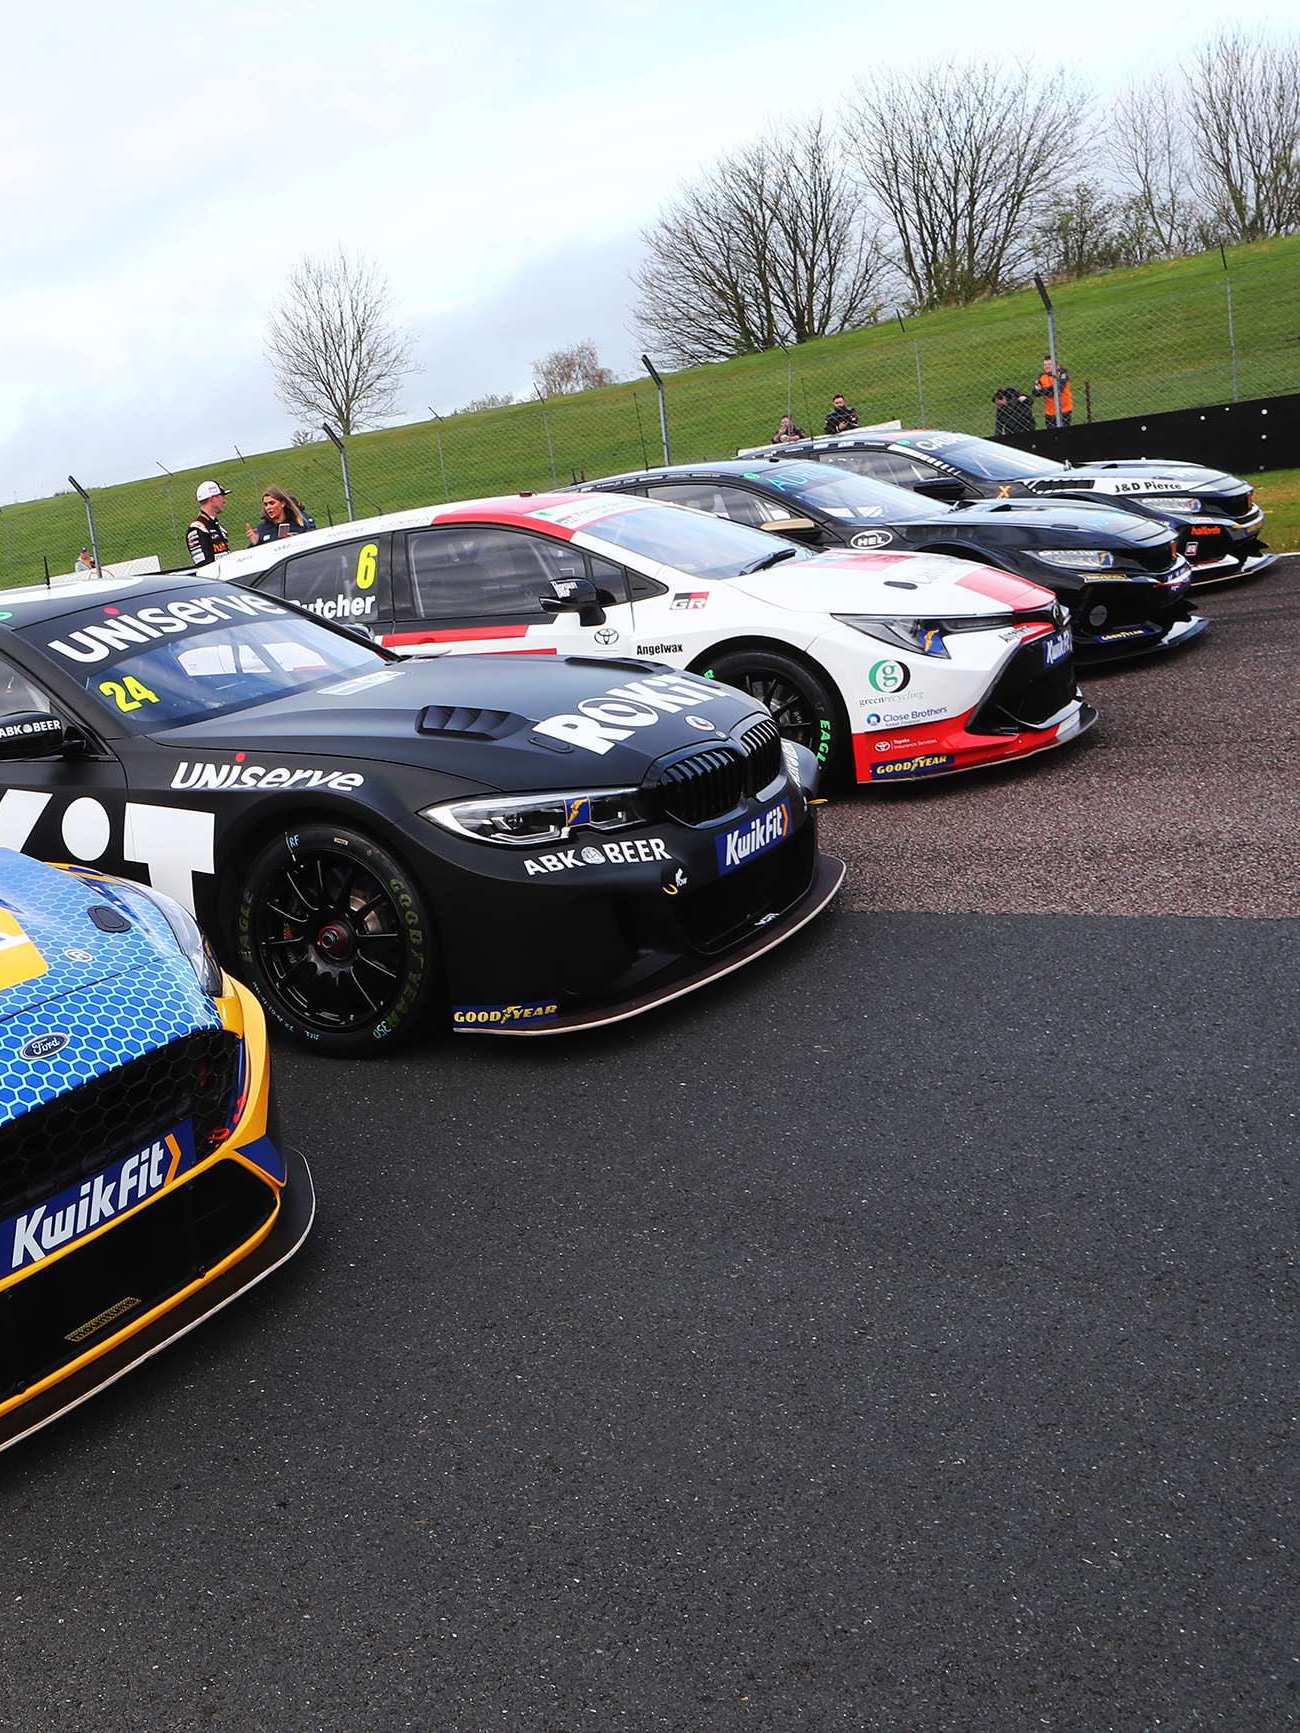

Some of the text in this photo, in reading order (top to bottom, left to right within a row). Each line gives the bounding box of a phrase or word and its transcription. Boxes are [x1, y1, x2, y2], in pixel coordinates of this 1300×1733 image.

[1114, 480, 1183, 493] J&D Pierce
[857, 534, 887, 547] HEL
[356, 543, 380, 590] 6
[636, 642, 684, 656] Angelwax
[98, 675, 161, 714] 24
[882, 706, 948, 723] Close Brothers
[33, 719, 62, 733] BEER
[816, 720, 832, 769] EAGL
[523, 837, 673, 877] ABK BEER
[30, 1037, 62, 1058] Ford
